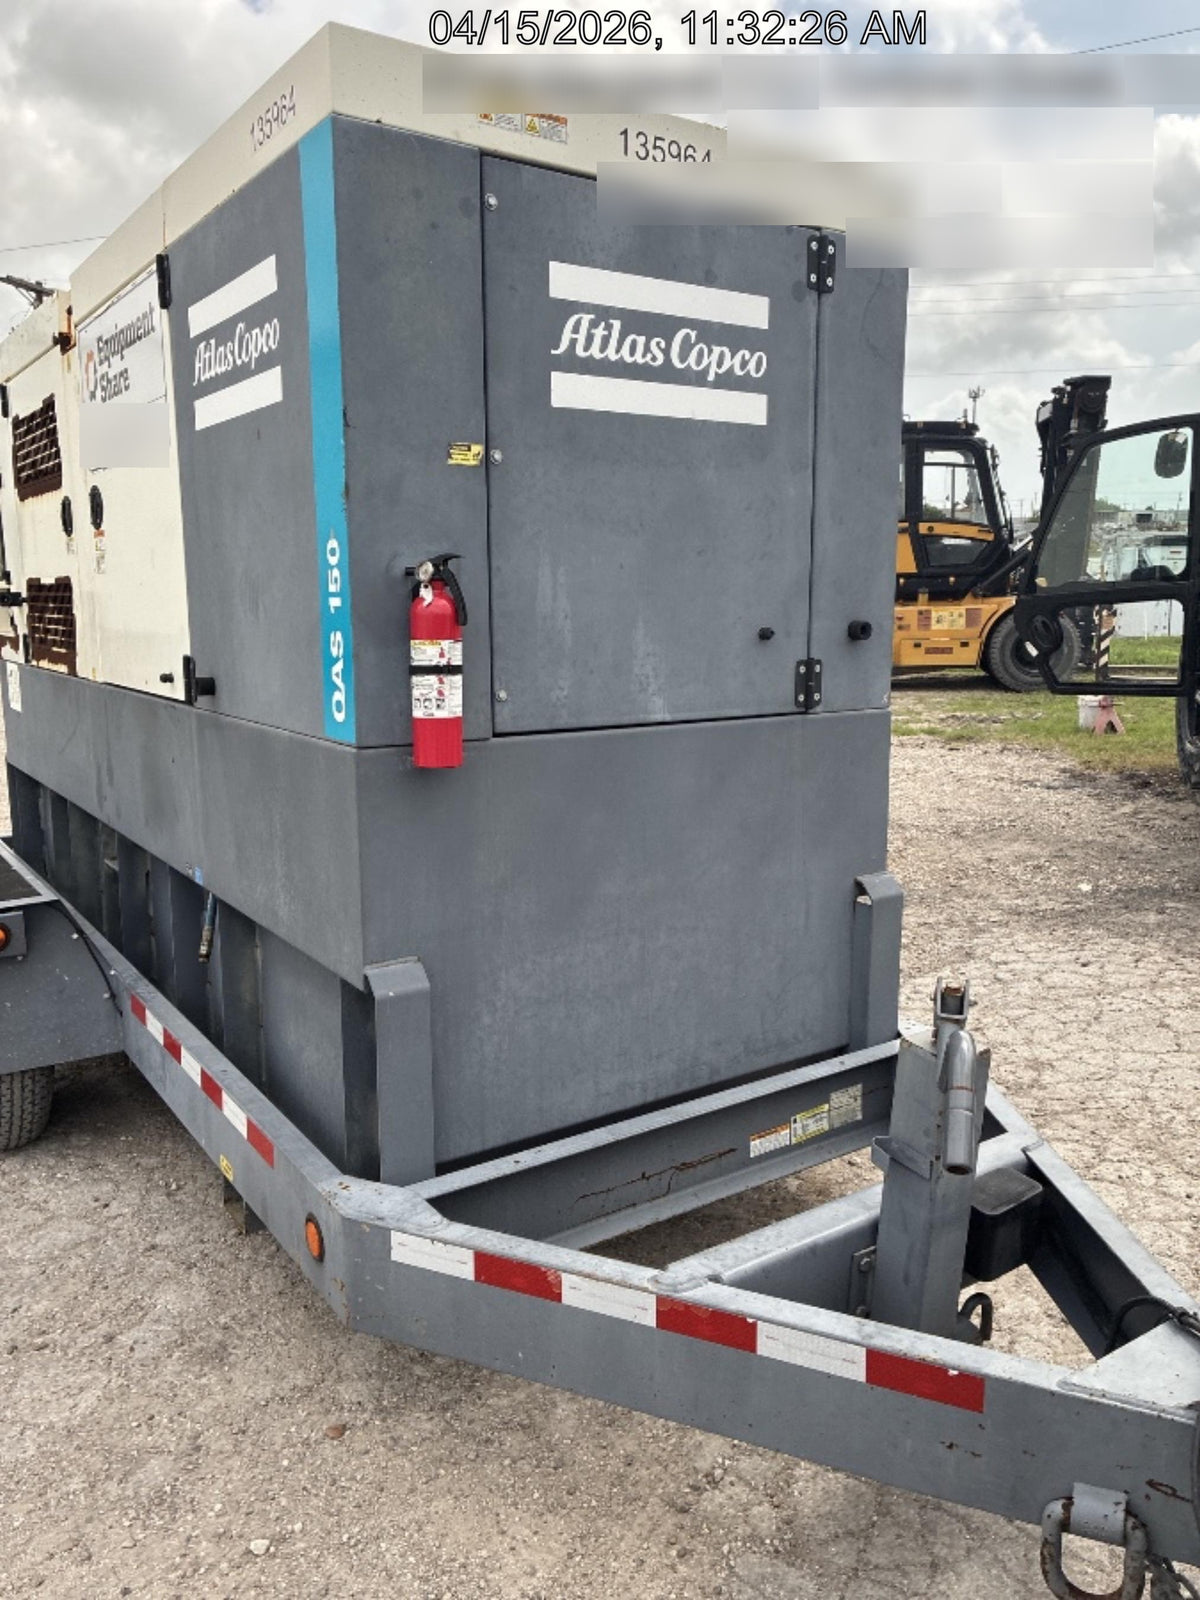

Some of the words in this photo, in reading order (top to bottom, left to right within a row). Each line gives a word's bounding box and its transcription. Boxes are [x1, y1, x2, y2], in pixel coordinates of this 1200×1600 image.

[250, 85, 296, 151] 135964
[97, 302, 156, 369] Equipment
[193, 339, 234, 387] Atlas
[234, 317, 280, 370] Copco
[550, 313, 666, 367] Atlas
[670, 328, 767, 381] Copco
[99, 367, 131, 403] Share
[326, 537, 342, 614] 150
[329, 630, 346, 723] QAS
